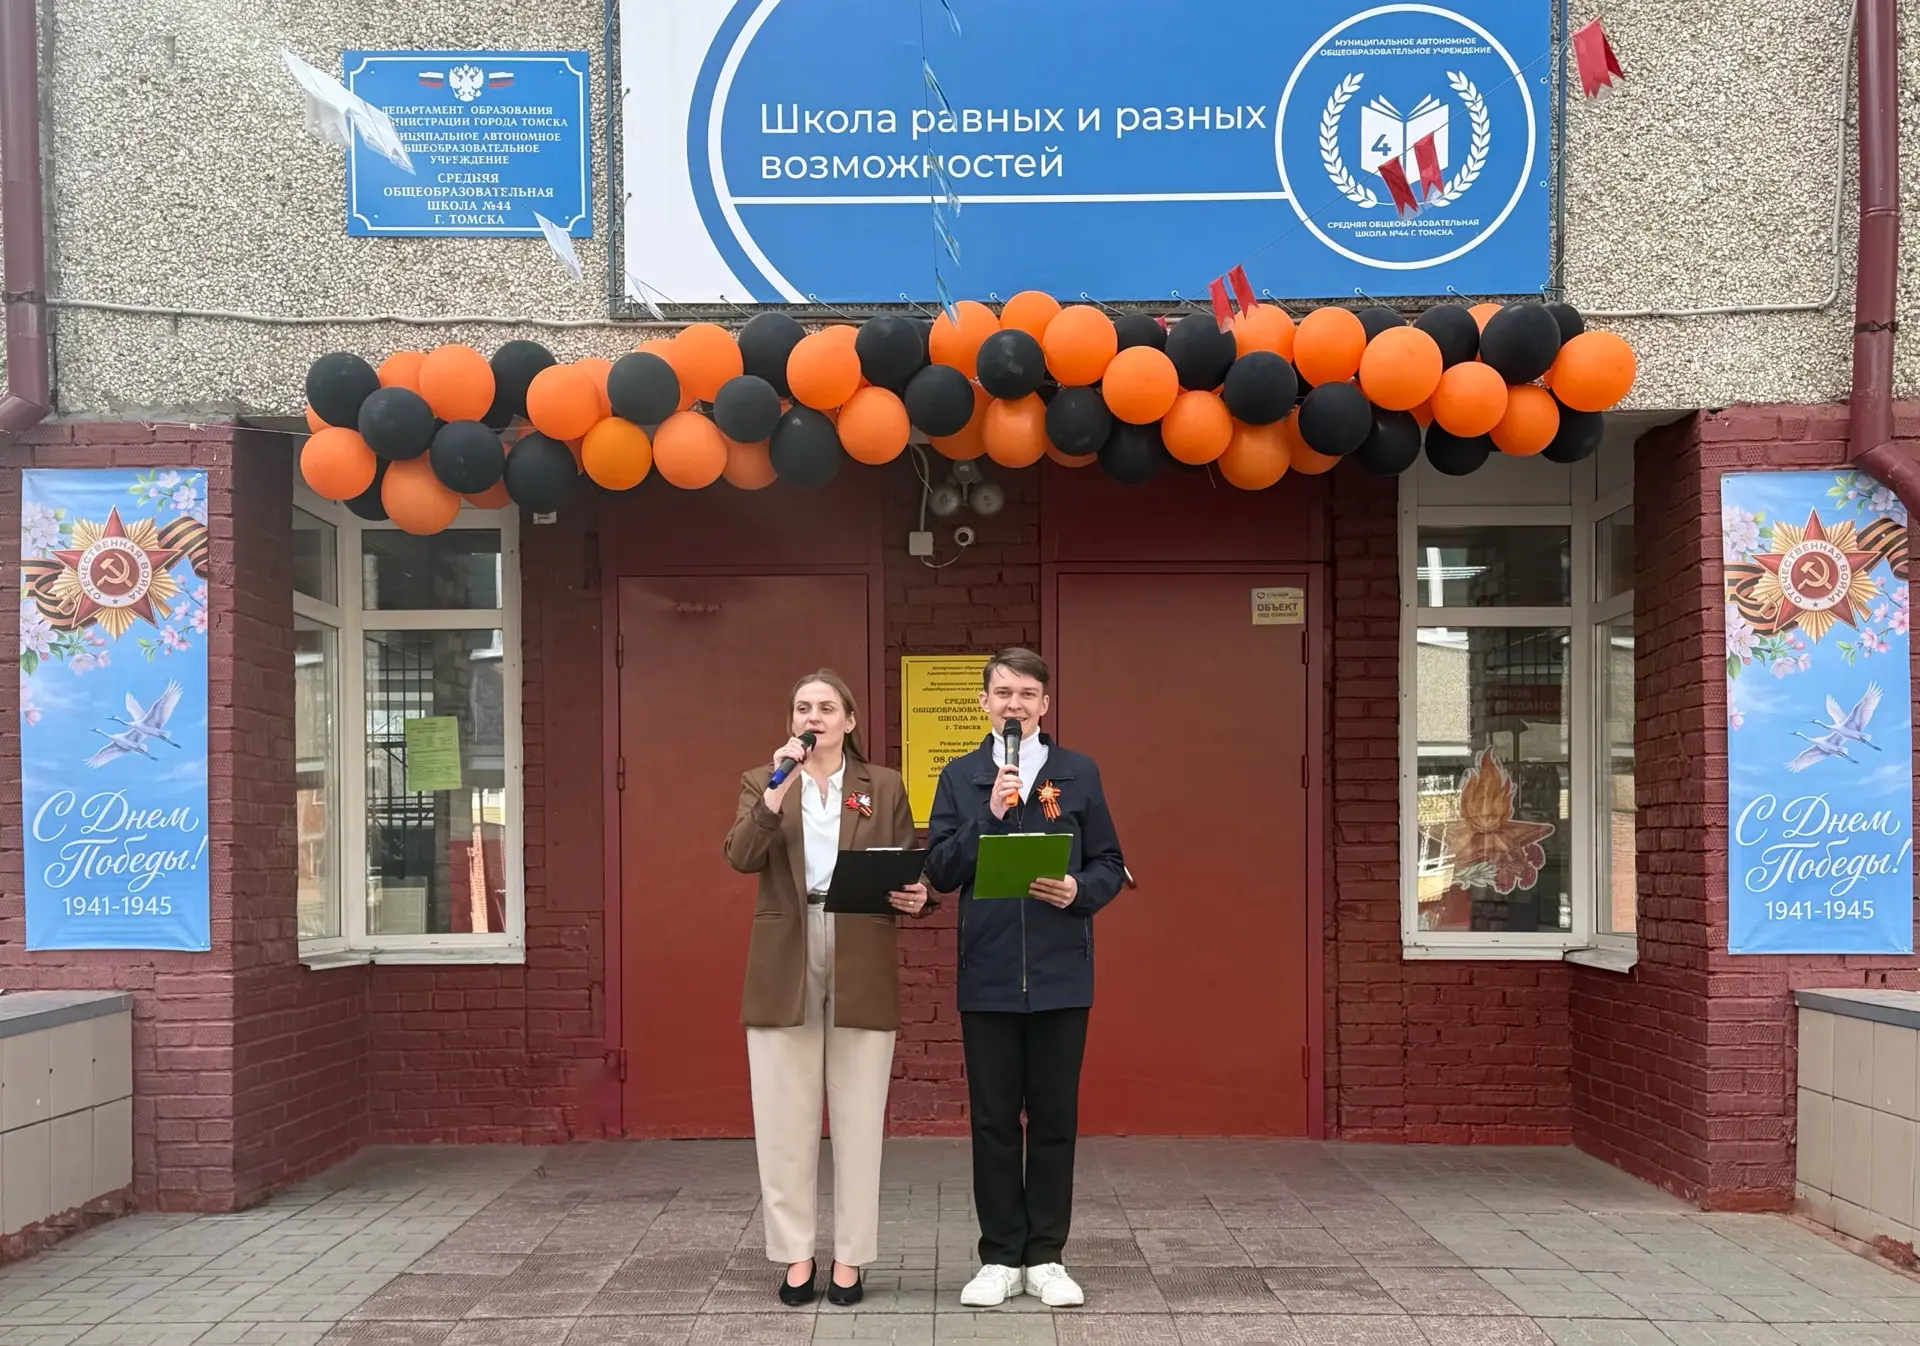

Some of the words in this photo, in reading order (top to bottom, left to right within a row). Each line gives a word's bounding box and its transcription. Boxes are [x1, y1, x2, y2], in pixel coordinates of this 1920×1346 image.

[1335, 39, 1415, 47] МУНИЦИПАЛЬНОЕ
[1416, 37, 1477, 46] АВТОНОМНОЕ
[1320, 47, 1431, 57] ОБЩЕОБРАЗОВАТЕЛЬНОЕ
[1432, 46, 1492, 55] УЧРЕЖДЕНИЕ
[470, 106, 553, 115] ОБРАЗОВАНИЯ
[474, 118, 517, 127] ГОРОДА
[521, 118, 568, 127] ТОМСКА
[760, 103, 897, 134] Школа
[911, 107, 1065, 139] равных
[1077, 108, 1101, 132] и
[1115, 104, 1267, 137] разных
[482, 132, 561, 142] АВТОНОМНОЕ
[430, 156, 509, 166] УЧРЕЖДЕНИЕ
[760, 146, 1064, 179] возможностей
[437, 172, 499, 184] СРЕДНЯЯ
[383, 186, 554, 199] ОБЩЕОБРАЗОВАТЕЛЬНАЯ
[427, 200, 477, 211] ШКОЛА
[482, 200, 511, 211] №44
[434, 213, 444, 224] Г.
[450, 213, 505, 225] ТОМСКА
[1327, 222, 1368, 230] СРЕДНЯЯ
[1368, 219, 1480, 228] ОБЩЕОБРАЗОВАТЕЛЬНАЯ
[1355, 230, 1388, 238] ШКОЛА
[1418, 229, 1454, 237] ТОМСКА
[80, 539, 144, 600] ОТЕЧЕСТВЕННАЯ
[1781, 543, 1843, 604] ОТЕЧЕСТВЕННАЯ
[1257, 603, 1298, 612] ОБЪЕКТ
[33, 790, 77, 843] С
[80, 789, 199, 832] Днем
[1735, 794, 1777, 846] С
[1780, 793, 1900, 837] Днем
[44, 834, 208, 892] Победы!
[1745, 838, 1912, 896] Победы!
[62, 897, 172, 916] 1941-1945
[1765, 901, 1874, 920] 1941-1945
